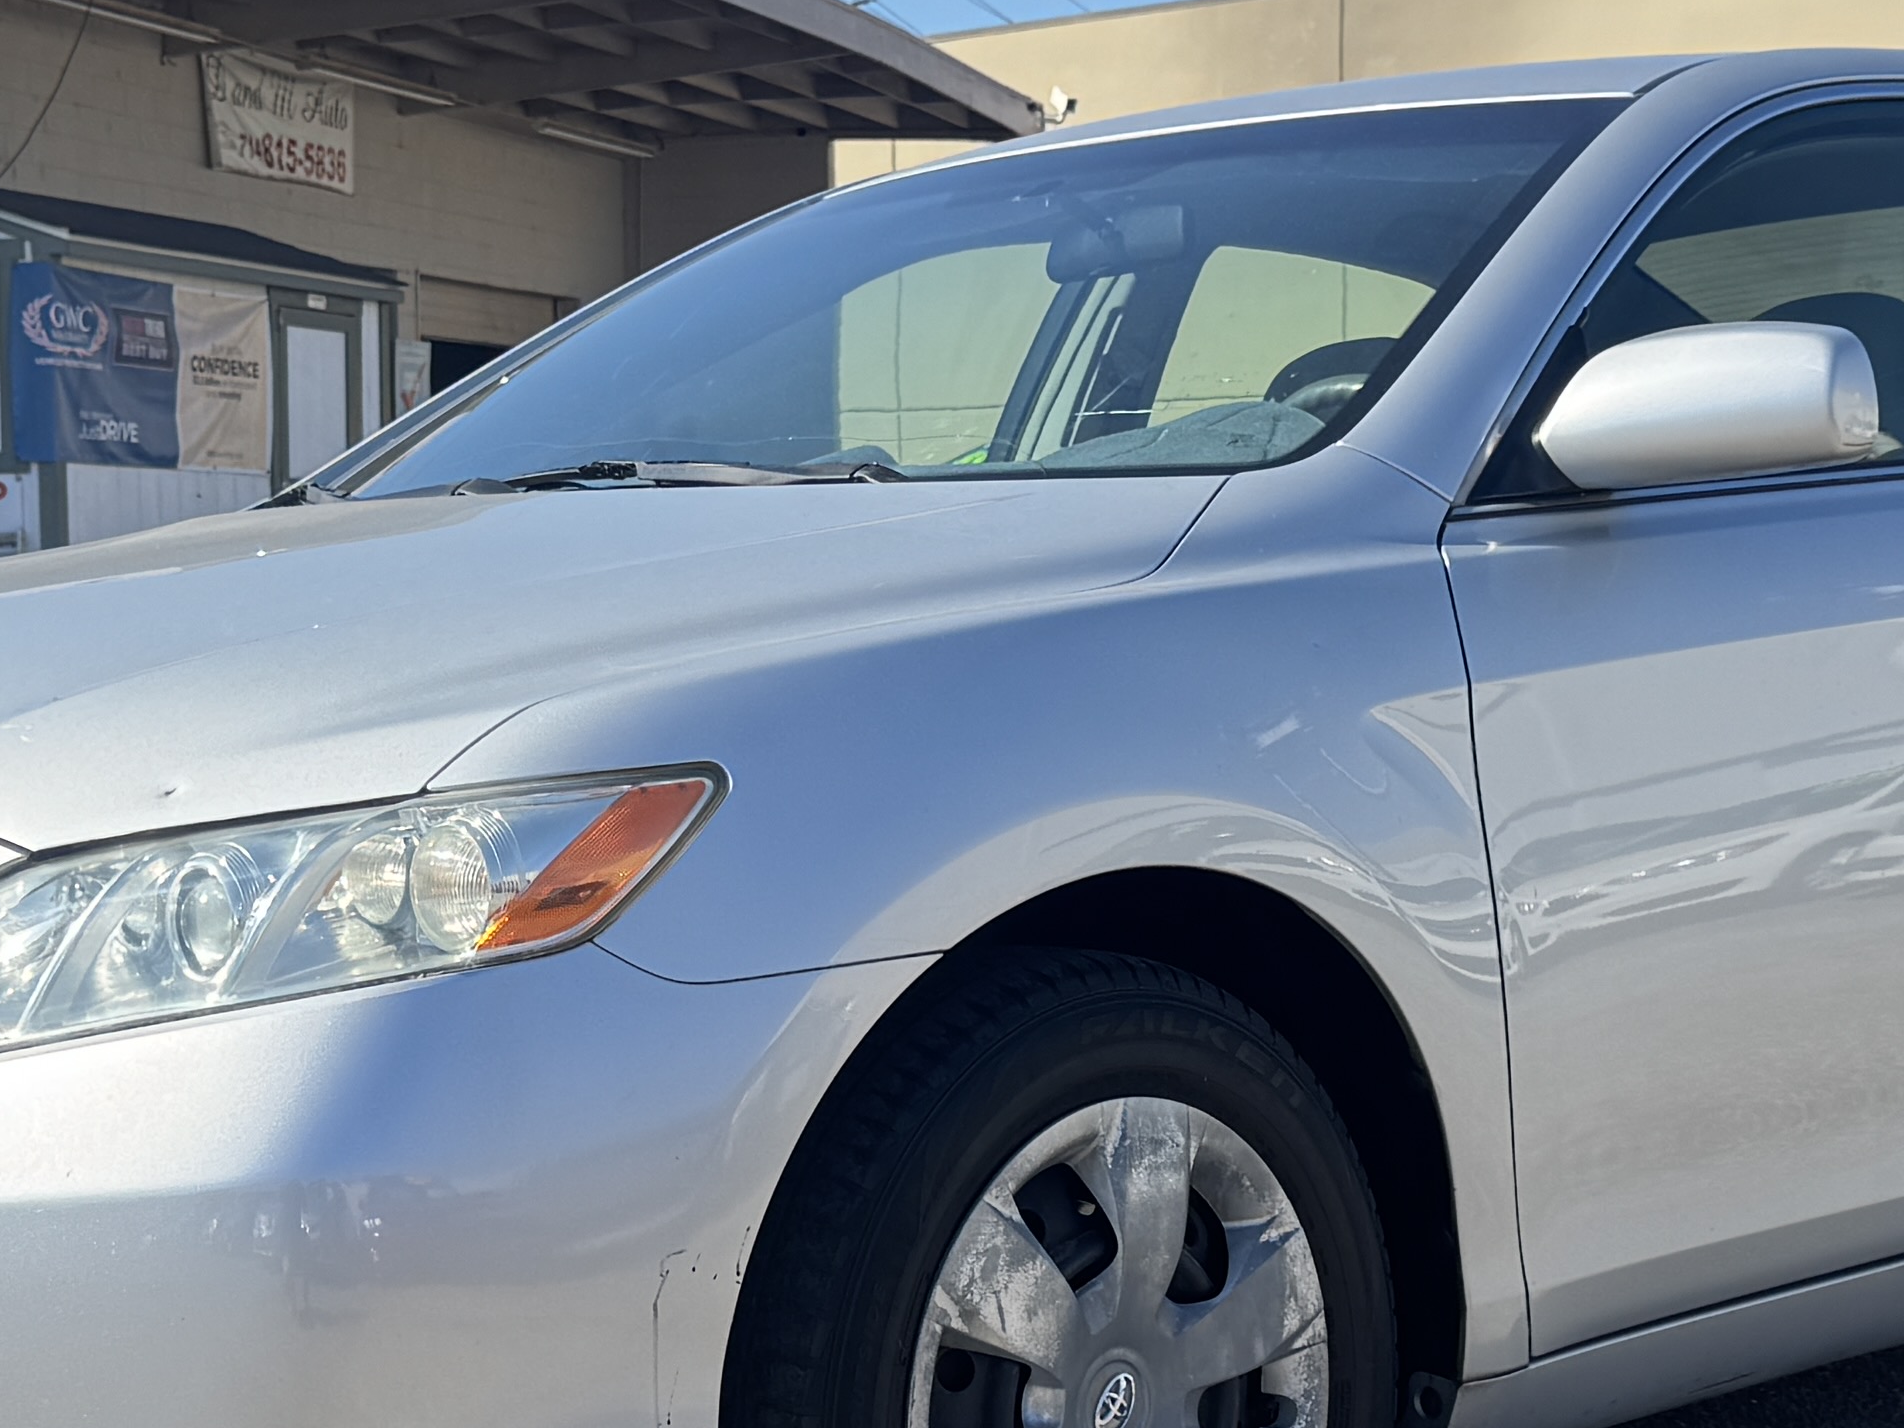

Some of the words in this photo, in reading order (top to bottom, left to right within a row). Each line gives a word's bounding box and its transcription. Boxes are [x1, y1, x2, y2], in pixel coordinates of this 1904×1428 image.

[232, 77, 263, 110] and
[303, 84, 348, 131] Auto
[49, 302, 93, 333] GWC
[190, 354, 261, 380] CONFIDENCE
